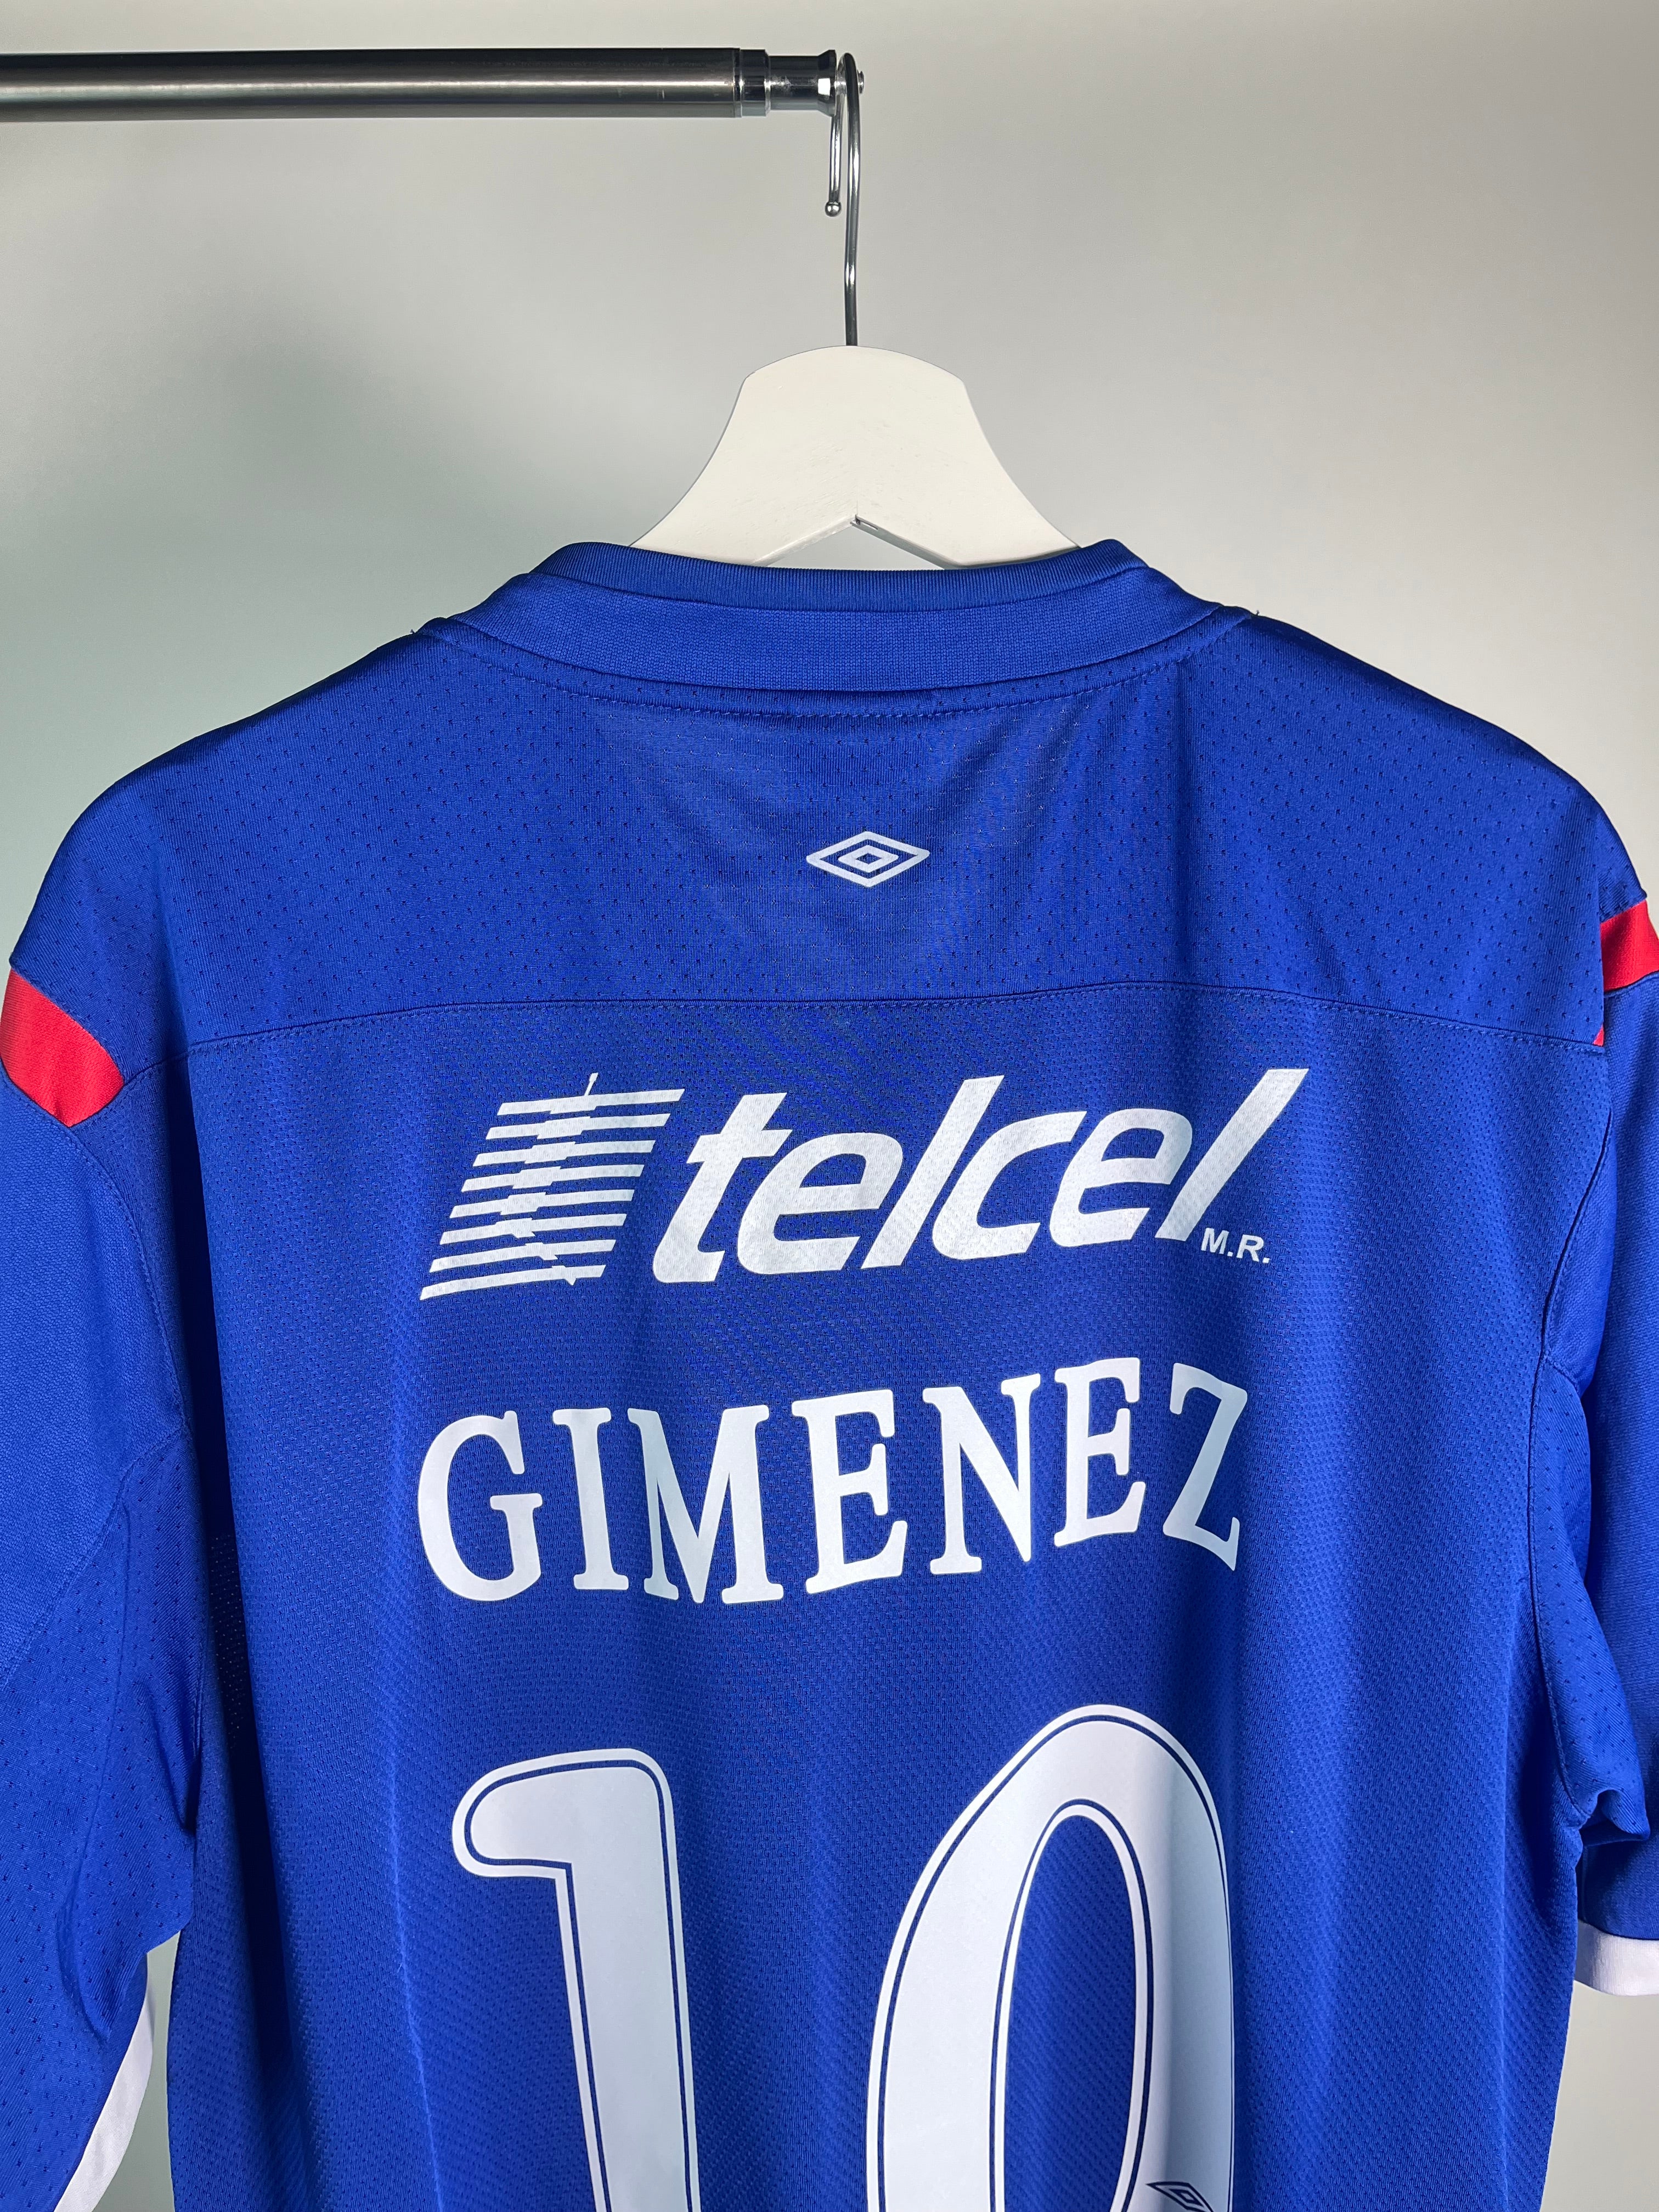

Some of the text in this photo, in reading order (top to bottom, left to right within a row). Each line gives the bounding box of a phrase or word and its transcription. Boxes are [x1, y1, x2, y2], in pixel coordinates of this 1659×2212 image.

[652, 1068, 1309, 1284] telcel
[1200, 1227, 1271, 1264] M.R.
[417, 1357, 1248, 1606] GIMENEZ
[452, 1704, 1234, 2212] 10
